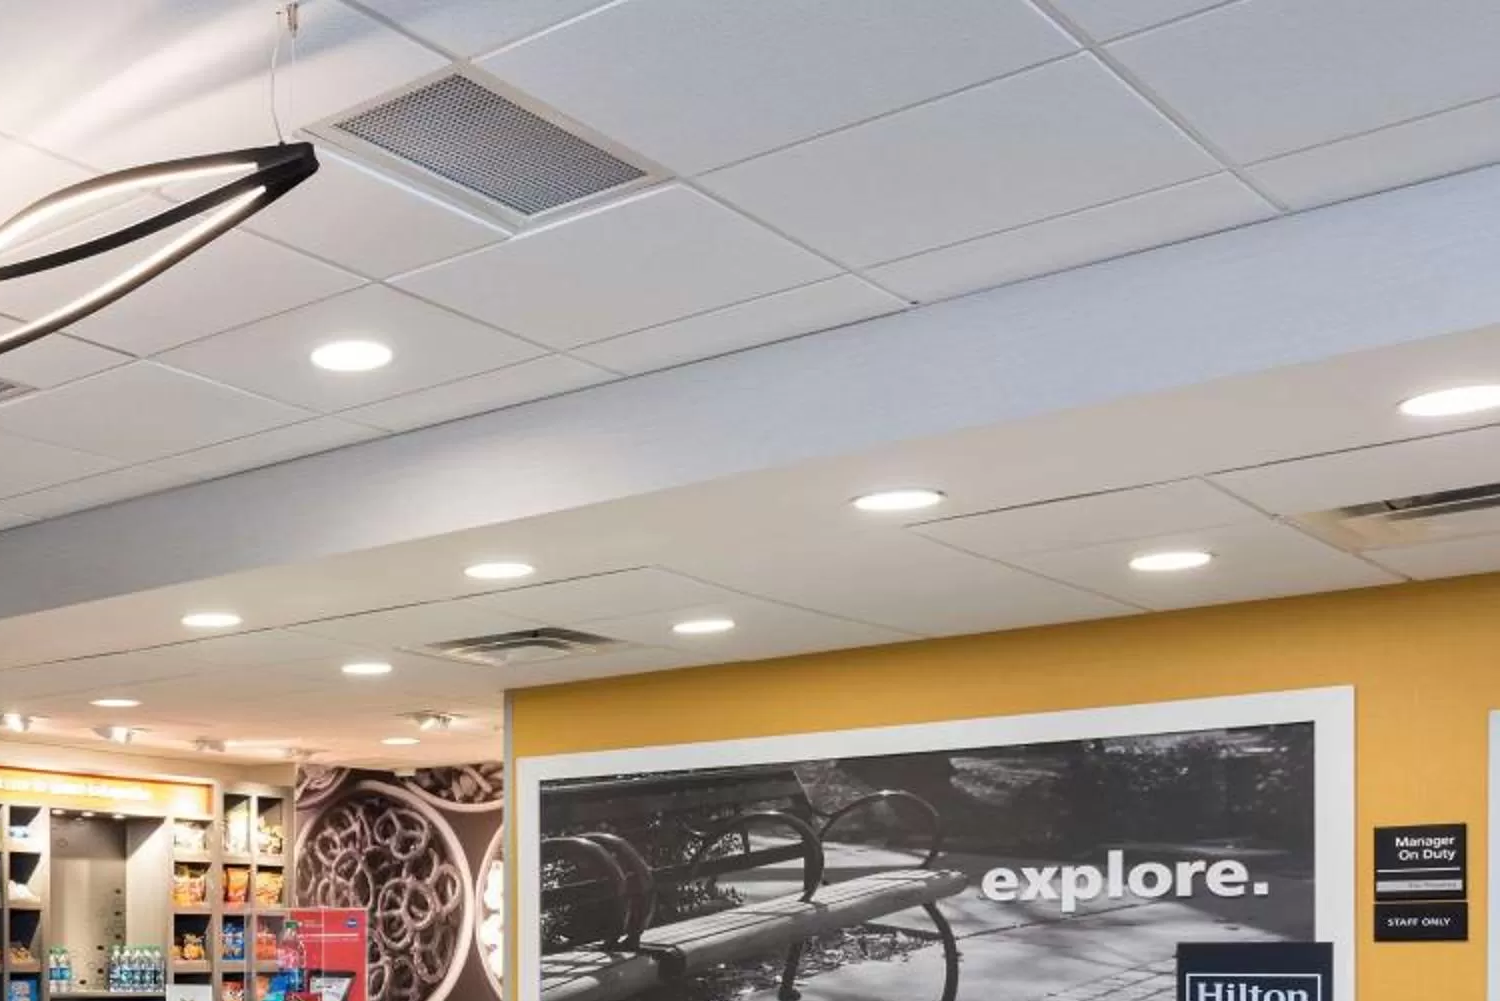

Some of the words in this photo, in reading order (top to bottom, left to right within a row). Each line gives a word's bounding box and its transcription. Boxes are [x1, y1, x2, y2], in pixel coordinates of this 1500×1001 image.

[1395, 837, 1455, 848] Manager
[1399, 850, 1419, 861] On
[1423, 849, 1456, 861] Duty
[981, 850, 1269, 912] explore.
[1387, 918, 1419, 927] STAFF
[1421, 918, 1451, 927] ONLY
